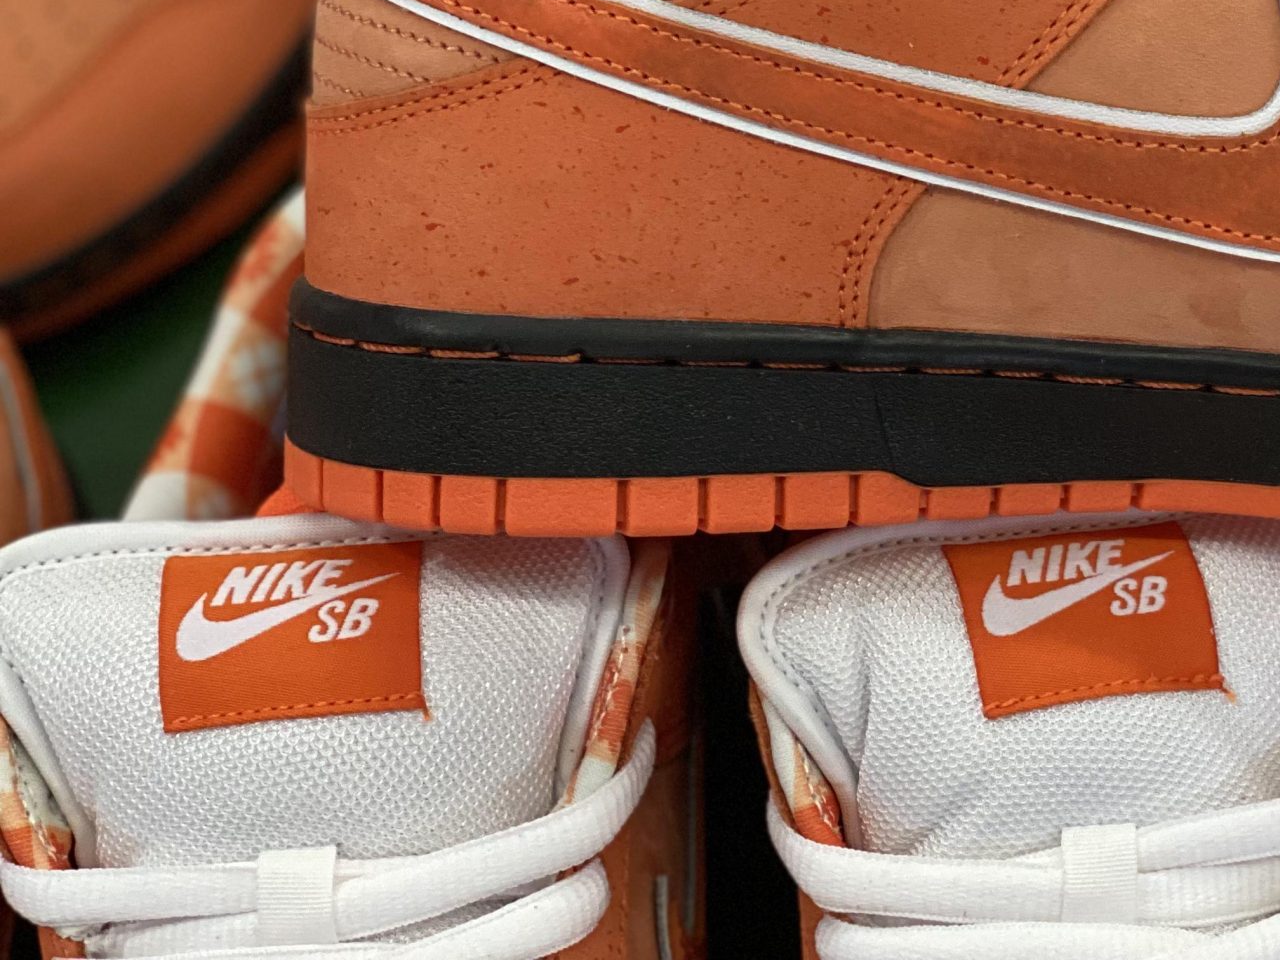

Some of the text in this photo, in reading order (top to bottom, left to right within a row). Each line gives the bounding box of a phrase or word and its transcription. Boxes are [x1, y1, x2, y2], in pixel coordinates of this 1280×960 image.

[210, 558, 354, 607] NIKE
[1007, 539, 1126, 587] NIKE
[1110, 575, 1168, 617] SB
[307, 597, 380, 643] SB
